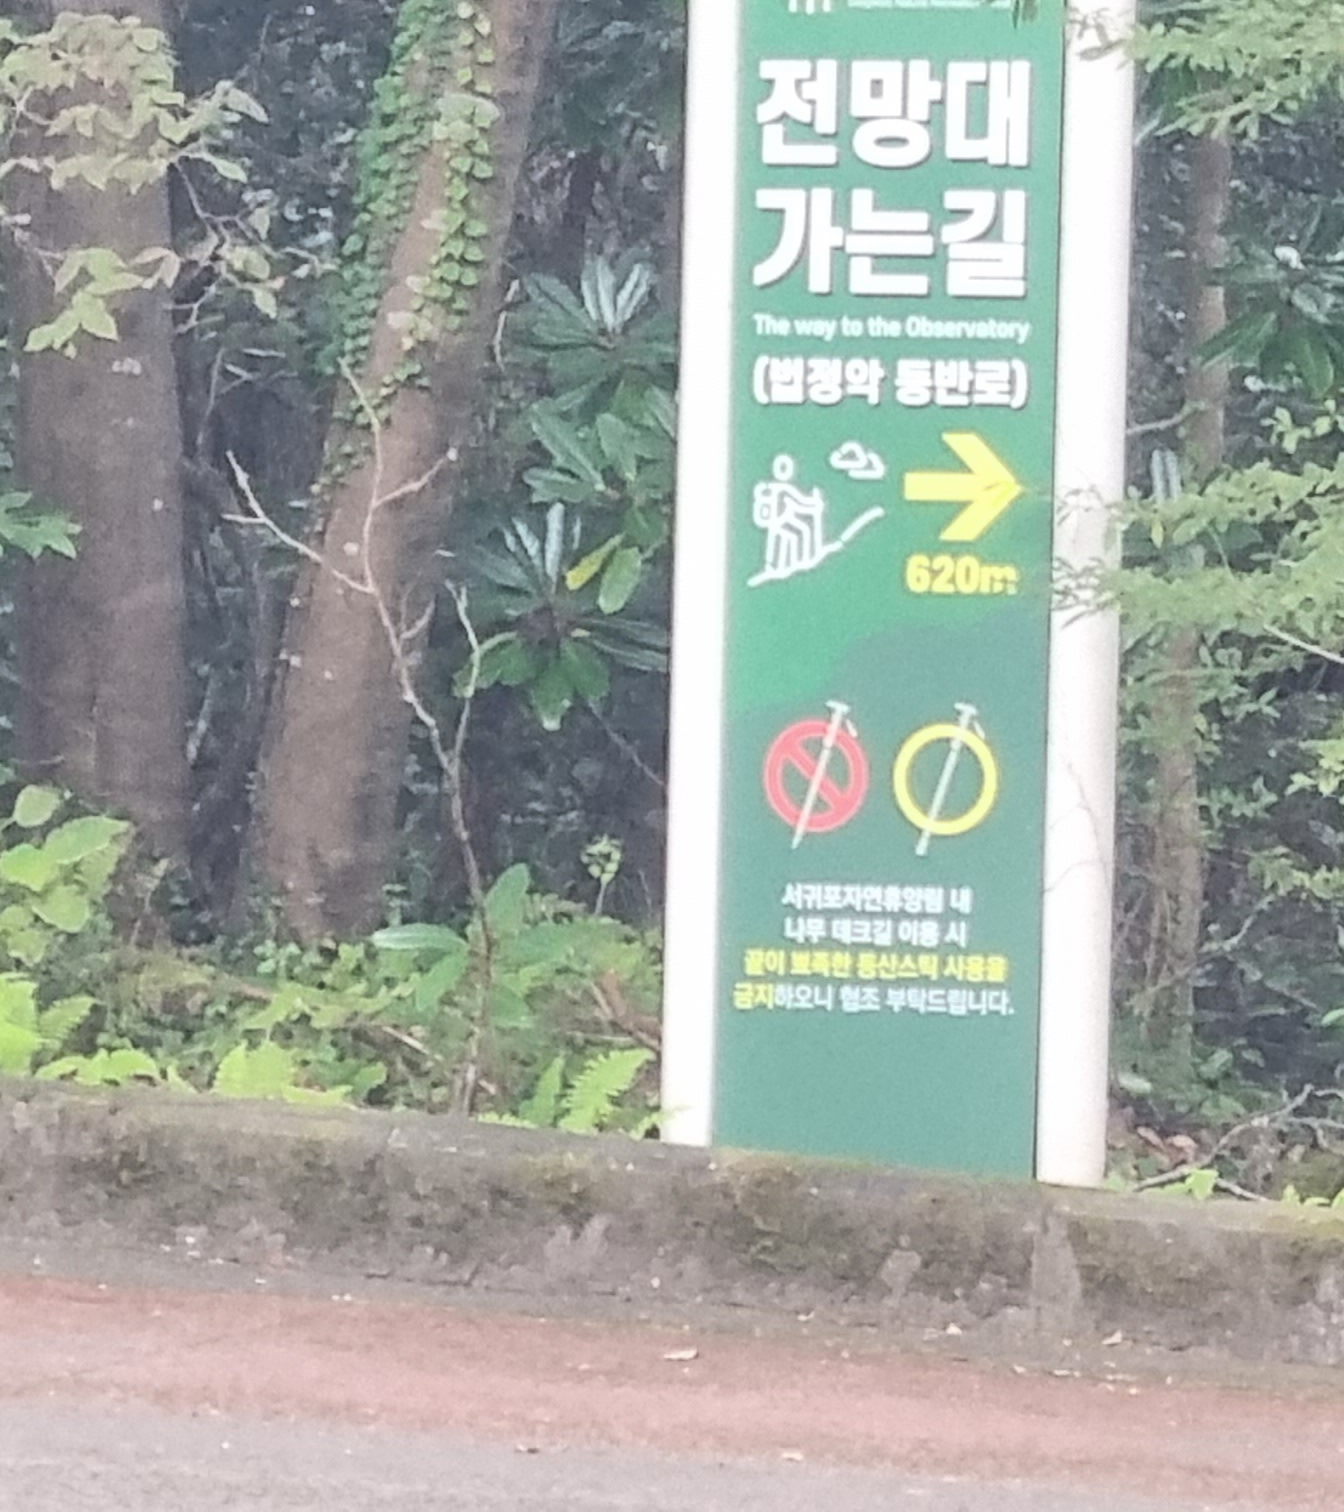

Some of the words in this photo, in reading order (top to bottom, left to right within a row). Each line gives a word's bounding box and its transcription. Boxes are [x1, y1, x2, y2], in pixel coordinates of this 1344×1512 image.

[756, 58, 1031, 168] 전망대
[752, 188, 1027, 298] 가는길
[753, 314, 788, 336] The
[795, 317, 836, 341] way
[841, 316, 863, 337] to
[867, 316, 901, 337] the
[905, 315, 1031, 345] Observatory
[906, 553, 1019, 595] 620m
[781, 882, 944, 914] 서귀포자연휴양림
[950, 885, 973, 915] 내
[784, 915, 826, 944] 나무
[831, 918, 892, 947] 데크길
[898, 920, 939, 948] 이용
[943, 920, 967, 948] 시
[857, 951, 939, 980] 등산스틱
[943, 953, 1008, 983] 사용을
[733, 981, 833, 1011] 금지하오니
[839, 985, 881, 1013] 협조
[886, 987, 1016, 1016] 부탁드립니다.
